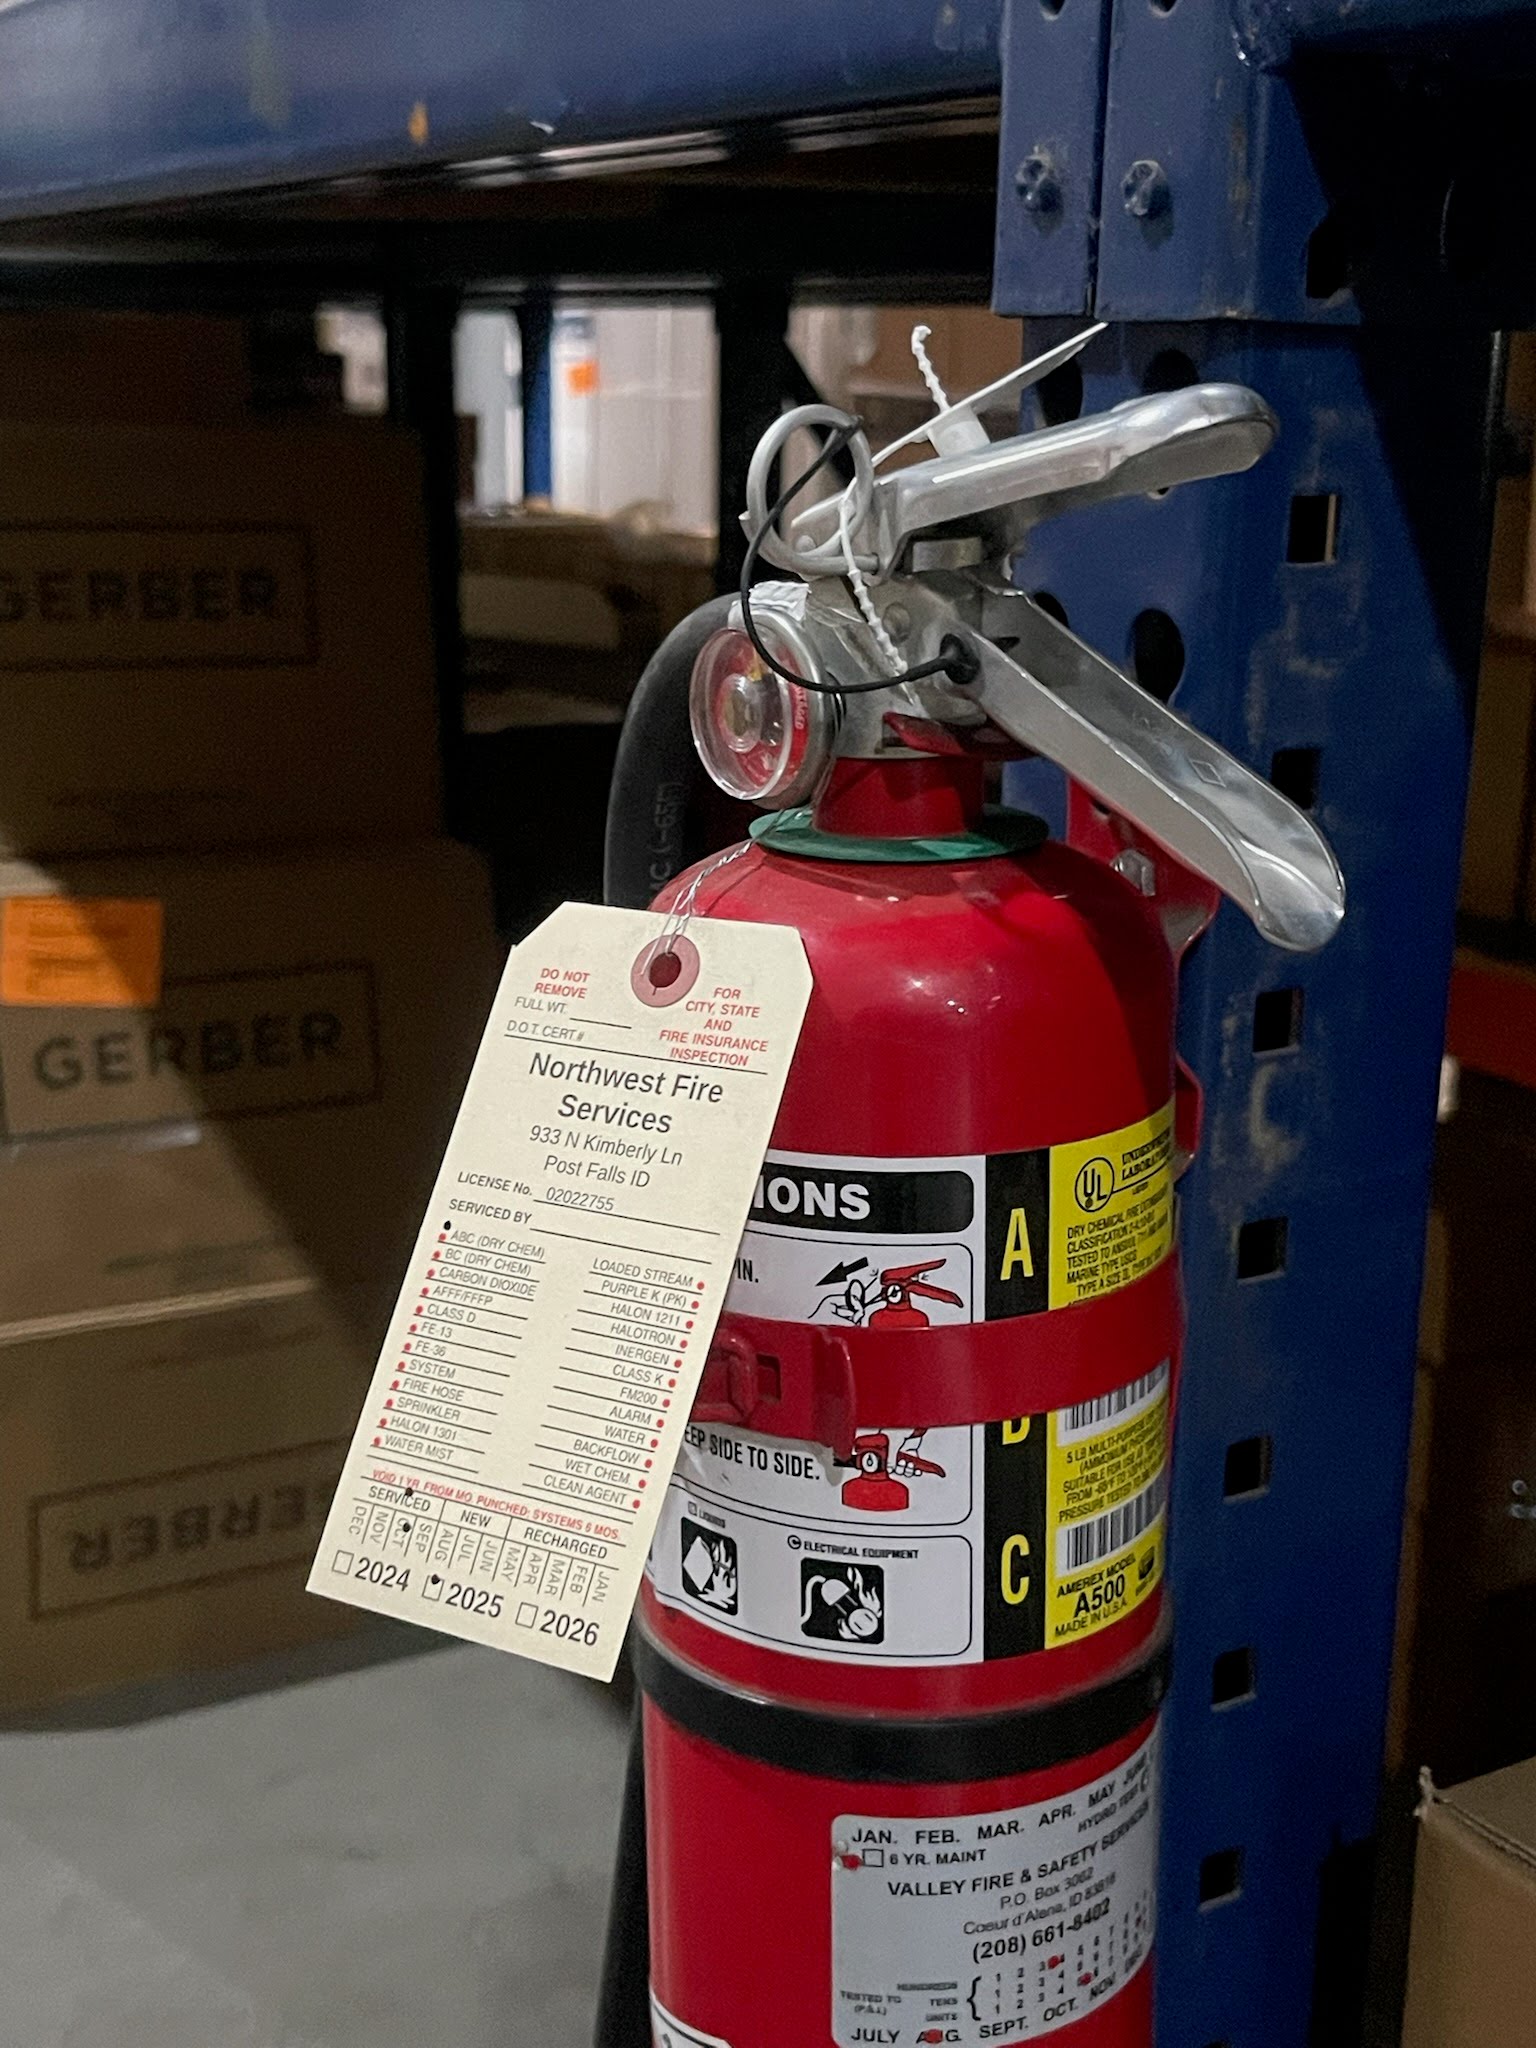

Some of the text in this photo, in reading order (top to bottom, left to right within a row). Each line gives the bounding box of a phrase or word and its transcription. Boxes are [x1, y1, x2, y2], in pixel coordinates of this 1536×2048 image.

[541, 968, 590, 983] DO NOT
[515, 997, 545, 1011] FULL
[534, 983, 588, 999] REMOVE
[713, 988, 741, 999] FOR
[686, 1001, 760, 1018] CITY, STATE
[704, 1019, 733, 1032] AND
[34, 1010, 344, 1090] GERBER
[659, 1030, 769, 1052] FIRE INSURANCE
[670, 1048, 749, 1066] INSPECTION
[529, 1052, 724, 1103] Northwest Fire
[557, 1094, 673, 1133] Services
[530, 1125, 683, 1166] 933 N Kimberly Ln
[544, 1155, 650, 1188] Post Falls ID
[1083, 1168, 1107, 1201] UL
[458, 1172, 615, 1211] LICENSE No. 02022755
[449, 1199, 533, 1225] SERVICED BY
[451, 1230, 545, 1259] ABC (DRY CHEM)
[1000, 1208, 1034, 1281] A
[1067, 1224, 1085, 1239] DRY
[445, 1248, 531, 1276] BC (DRY CHEM)
[592, 1258, 694, 1287] LOADED STREAM
[1067, 1250, 1098, 1269] TESTED
[439, 1266, 537, 1297] CARBON DIOXIDE
[601, 1280, 687, 1309] PURPLE K (PK)
[1077, 1280, 1097, 1297] TYPE
[433, 1285, 494, 1306] AFFF/FFFP
[427, 1303, 477, 1323] CLASS D
[610, 1302, 680, 1326] HALON 1211
[421, 1321, 452, 1338] FE-13
[610, 1323, 676, 1346] HALOTRON
[415, 1340, 447, 1357] FE-36
[615, 1344, 670, 1365] INERGEN
[409, 1359, 456, 1379] SYSTEM
[612, 1364, 664, 1386] CLASS K
[402, 1378, 465, 1402] FIRE HOSE
[619, 1387, 658, 1405] FM200
[397, 1397, 461, 1421] SPRINKLER
[609, 1406, 652, 1425] ALARM
[390, 1416, 458, 1441] HALON 1301
[604, 1425, 646, 1445] WATER
[385, 1435, 455, 1461] WATER MIST
[573, 1438, 640, 1465] BACKFLOW
[709, 1435, 820, 1480] SIDE TO SIDE.
[565, 1458, 593, 1474] WET
[543, 1474, 627, 1505] CLEAN AGENT
[1063, 1467, 1105, 1493] SUITABLE
[368, 1486, 431, 1512] SERVICED
[373, 1469, 397, 1483] VOID
[399, 1476, 405, 1485] 1
[424, 1482, 455, 1496] FROM
[532, 1509, 583, 1528] SYSTEMS
[585, 1522, 592, 1532] 6
[1059, 1495, 1105, 1522] PRESSURE
[349, 1506, 367, 1536] DEC
[370, 1511, 389, 1544] NOV
[460, 1510, 492, 1528] NEW
[416, 1523, 433, 1553] SEP
[435, 1528, 454, 1562] AUG
[458, 1534, 475, 1562] JUL
[524, 1527, 608, 1559] RECHARGED
[804, 1541, 919, 1559] ELECTRICAL EQUIPMENT
[480, 1540, 498, 1572] JUN
[502, 1546, 521, 1583] MAY
[523, 1553, 542, 1585] APR
[1001, 1534, 1030, 1605] C
[355, 1557, 411, 1592] 2024
[544, 1559, 566, 1597] MAR
[570, 1565, 588, 1594] FEB
[592, 1571, 610, 1603] JAN
[1057, 1570, 1105, 1598] AMEREX
[445, 1583, 505, 1618] 2025
[1074, 1573, 1125, 1619] A500
[540, 1609, 600, 1647] 2026
[1054, 1616, 1088, 1637] MADE
[852, 1828, 898, 1844] JAN.
[915, 1829, 960, 1844] FEB.
[977, 1820, 1025, 1840] MAR.
[1038, 1804, 1076, 1828] APR.
[888, 1841, 1098, 1896] VALLEY FIRE & SAFETY
[889, 1853, 899, 1865] 6
[936, 1848, 987, 1865] MAINT
[1035, 1884, 1060, 1901] Box
[963, 1917, 1009, 1936] Coeur
[973, 1934, 1027, 1964] (208)
[851, 2028, 900, 2043] JULY
[979, 2016, 1029, 2039] SEPT.
